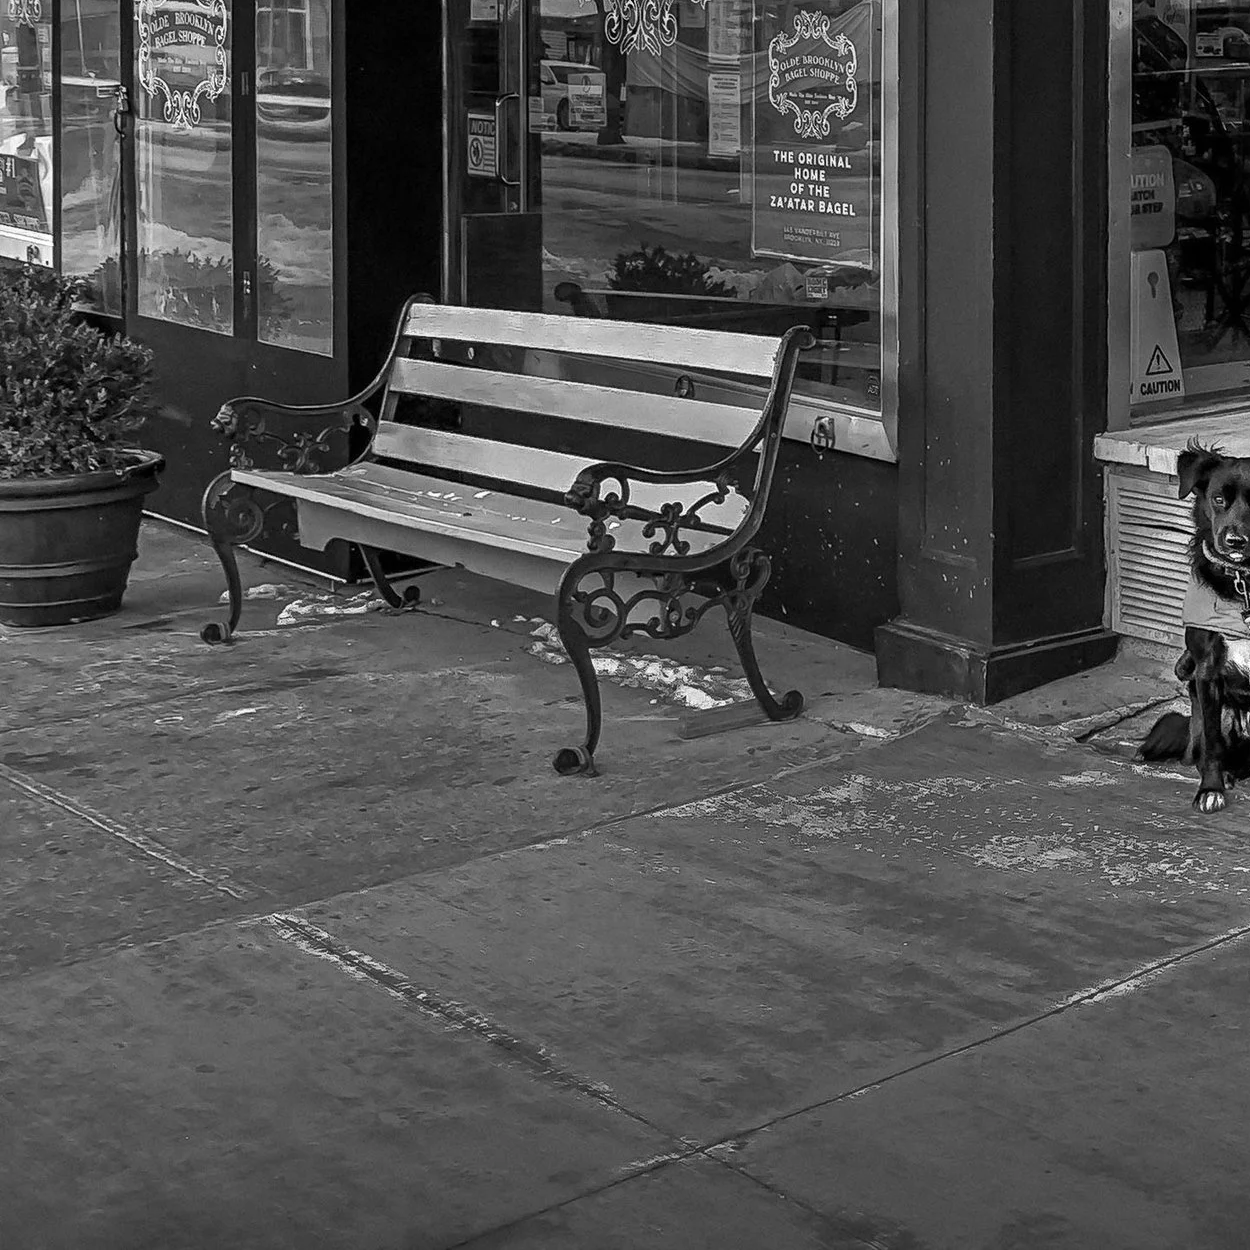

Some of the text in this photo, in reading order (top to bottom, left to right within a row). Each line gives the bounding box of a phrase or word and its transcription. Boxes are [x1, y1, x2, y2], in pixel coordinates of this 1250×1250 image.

[150, 12, 215, 35] OLDE BROOKLYN
[154, 30, 207, 48] BAGEL SHOPPE
[780, 55, 845, 73] OLDE BROOKLYN
[785, 68, 841, 85] BAGEL SHOPPE
[471, 120, 495, 135] NOTIC
[773, 150, 852, 169] THE ORIGINAL
[794, 167, 826, 182] HOME
[1130, 173, 1165, 188] UTION
[790, 182, 830, 198] OF THE
[770, 196, 856, 217] ZA'ATAR BAGEL
[1140, 379, 1181, 396] CAUTION
